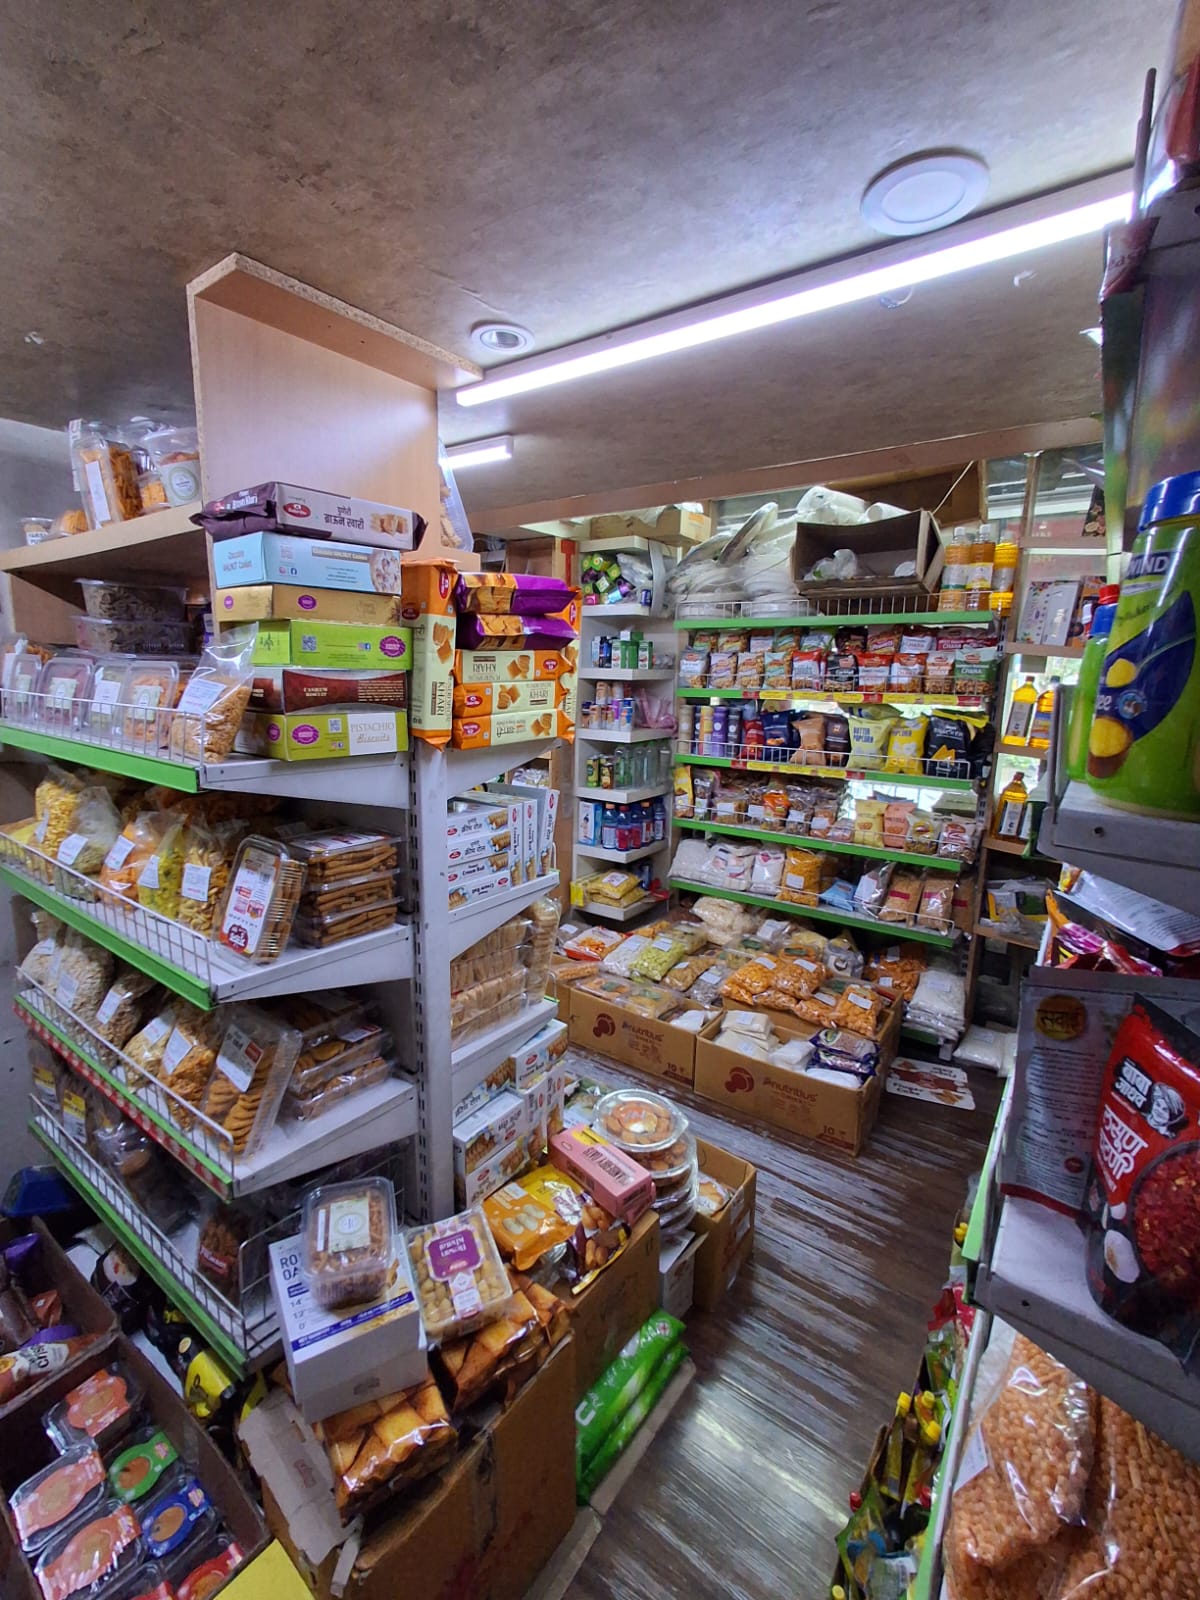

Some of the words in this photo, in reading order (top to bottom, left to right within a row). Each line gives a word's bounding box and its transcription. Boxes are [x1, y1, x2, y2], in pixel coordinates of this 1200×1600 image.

[475, 664, 497, 674] KHARI
[436, 681, 445, 716] KHARI
[350, 721, 394, 733] PISTACHIO
